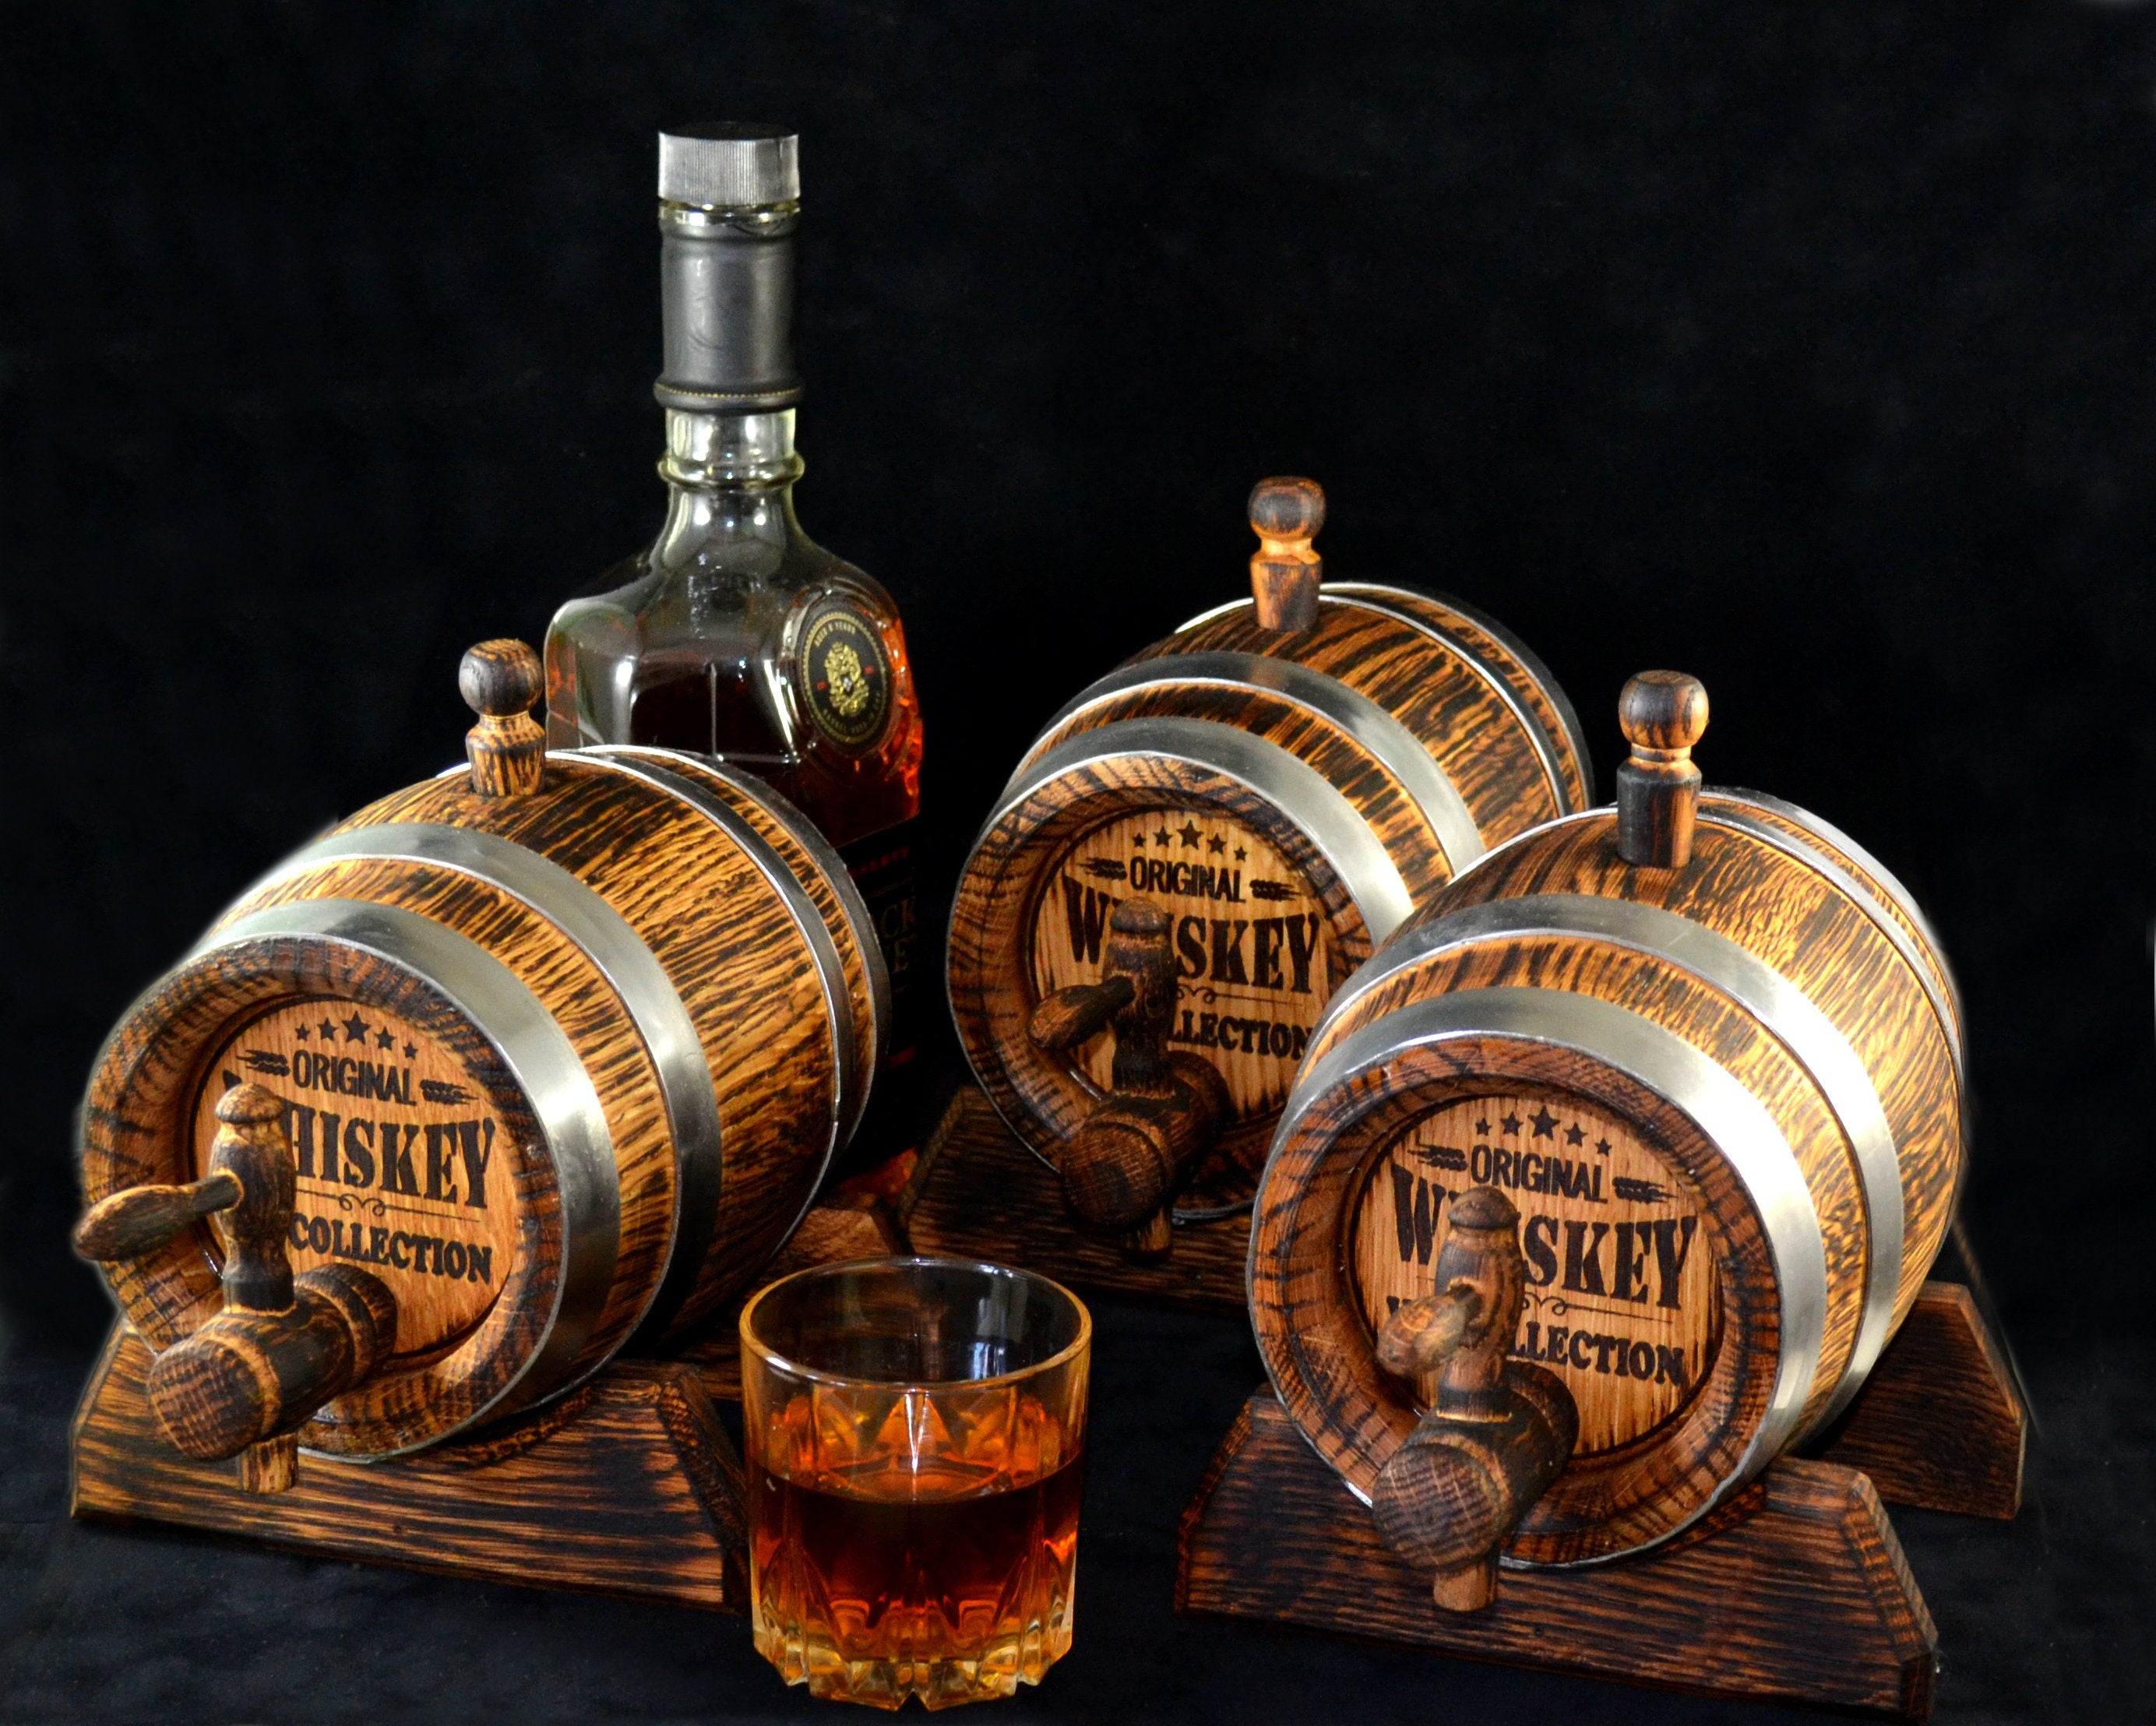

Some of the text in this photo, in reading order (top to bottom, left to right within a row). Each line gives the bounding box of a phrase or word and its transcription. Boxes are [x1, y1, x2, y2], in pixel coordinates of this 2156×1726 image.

[1129, 855, 1246, 904] ORIGINAL
[1063, 875, 1320, 994] WSKEY
[291, 1048, 417, 1107] ORIGINAL
[222, 1069, 496, 1209] HISKEY
[1470, 1143, 1608, 1204] ORIGINAL
[287, 1211, 492, 1285] COLLECTION
[1390, 1163, 1697, 1311] WSKEY
[1507, 1319, 1685, 1386] LECTION
